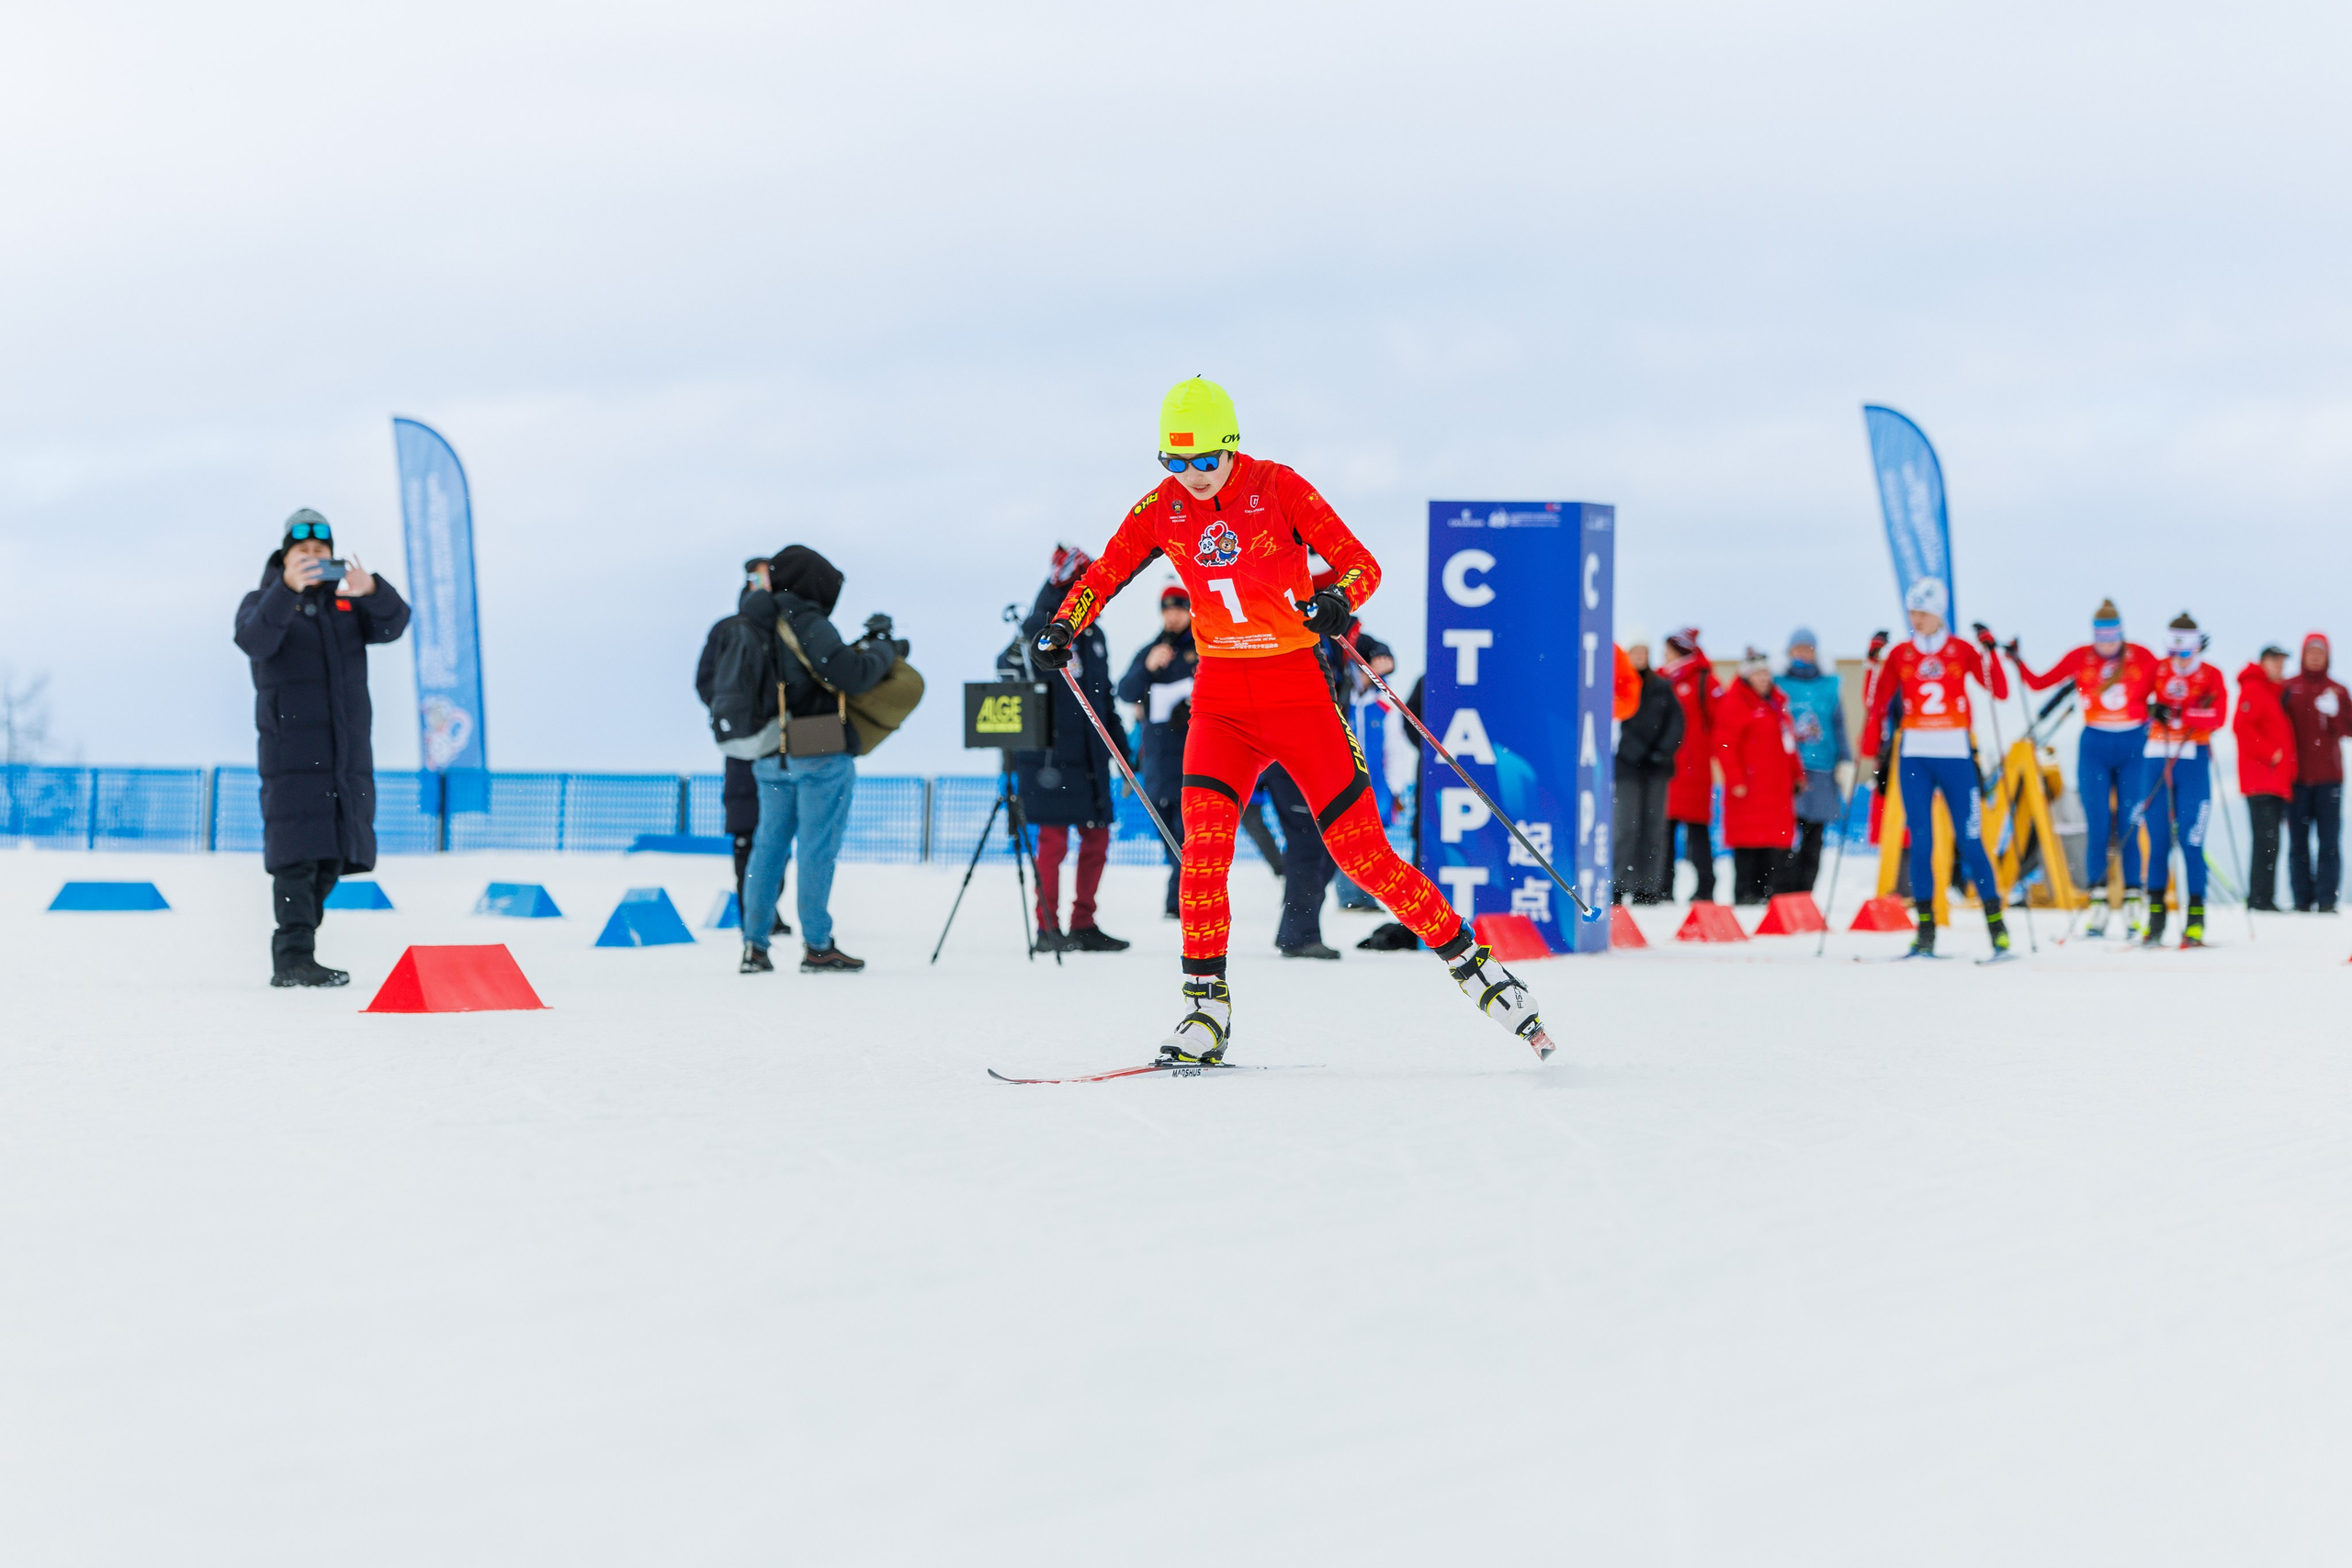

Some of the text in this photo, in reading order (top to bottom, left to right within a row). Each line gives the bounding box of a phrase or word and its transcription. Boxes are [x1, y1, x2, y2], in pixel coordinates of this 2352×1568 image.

[1208, 578, 1249, 624] 1
[1283, 588, 1299, 613] 1
[1918, 682, 1948, 716] 2
